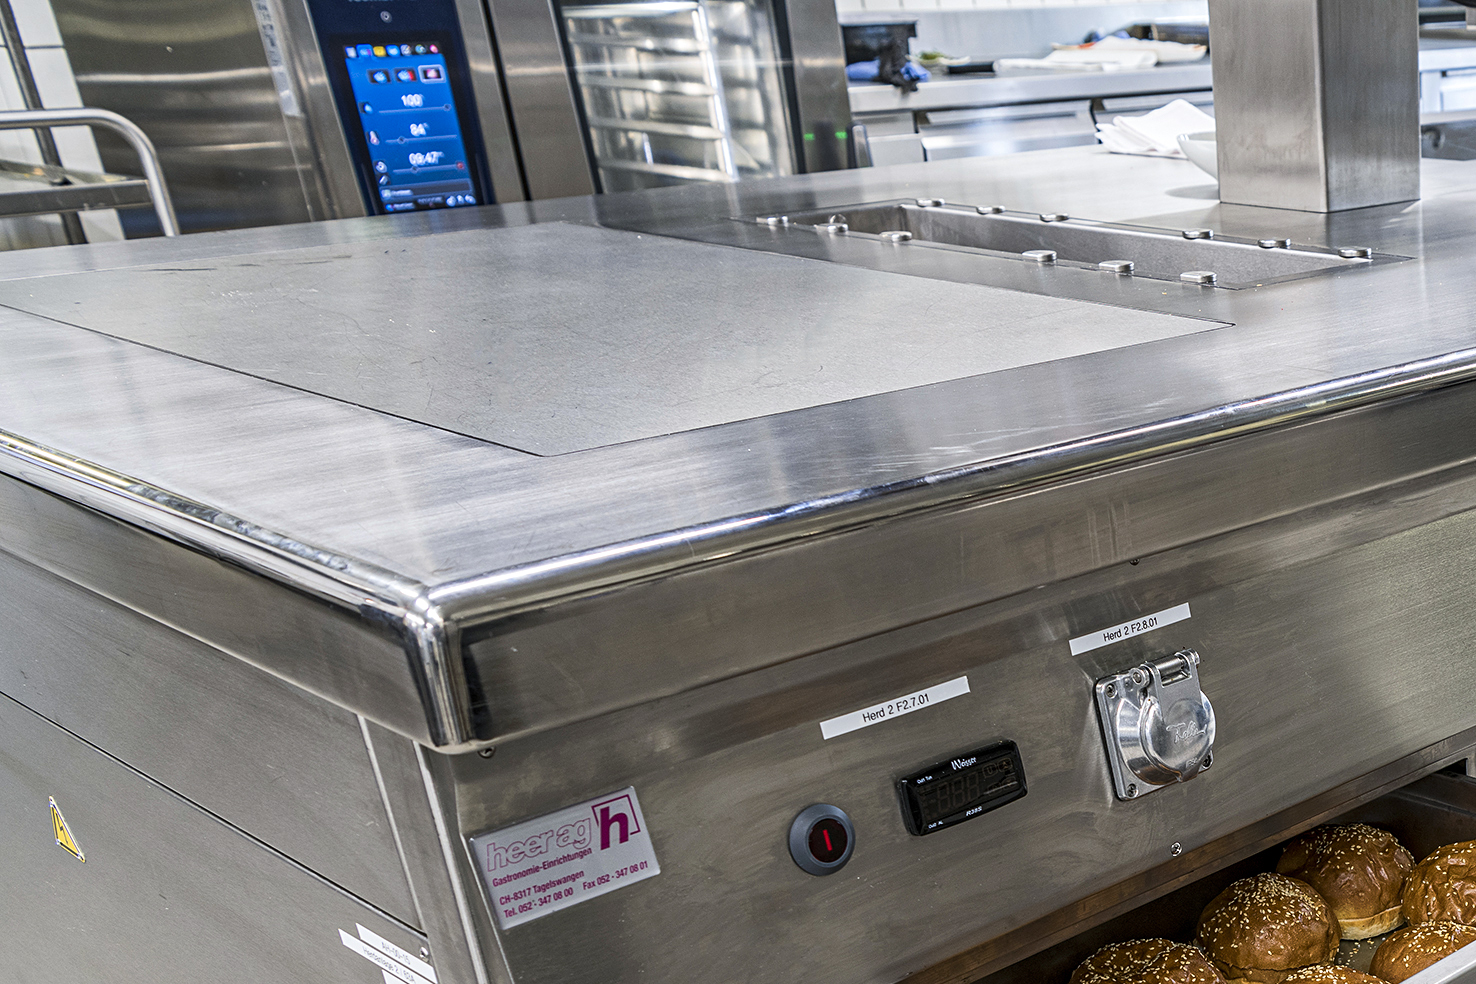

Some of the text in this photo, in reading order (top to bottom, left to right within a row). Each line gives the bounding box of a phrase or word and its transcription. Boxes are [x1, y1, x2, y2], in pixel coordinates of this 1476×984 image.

[1103, 617, 1158, 642] Herd 2 F2.8.01
[862, 693, 930, 723] Herd 2 F2.7.01
[492, 848, 592, 887] Gastronomie-Einrichtungen
[582, 880, 596, 890] Fax
[596, 874, 610, 885] 052
[615, 867, 628, 879] 347
[629, 863, 639, 874] 08
[639, 860, 648, 870] 01
[499, 870, 585, 905] CH-8317 Tagelswangen
[504, 907, 517, 918] Tel.
[518, 902, 532, 914] 052
[538, 895, 551, 907] 347
[553, 890, 563, 901] 08
[563, 887, 574, 897] 00
